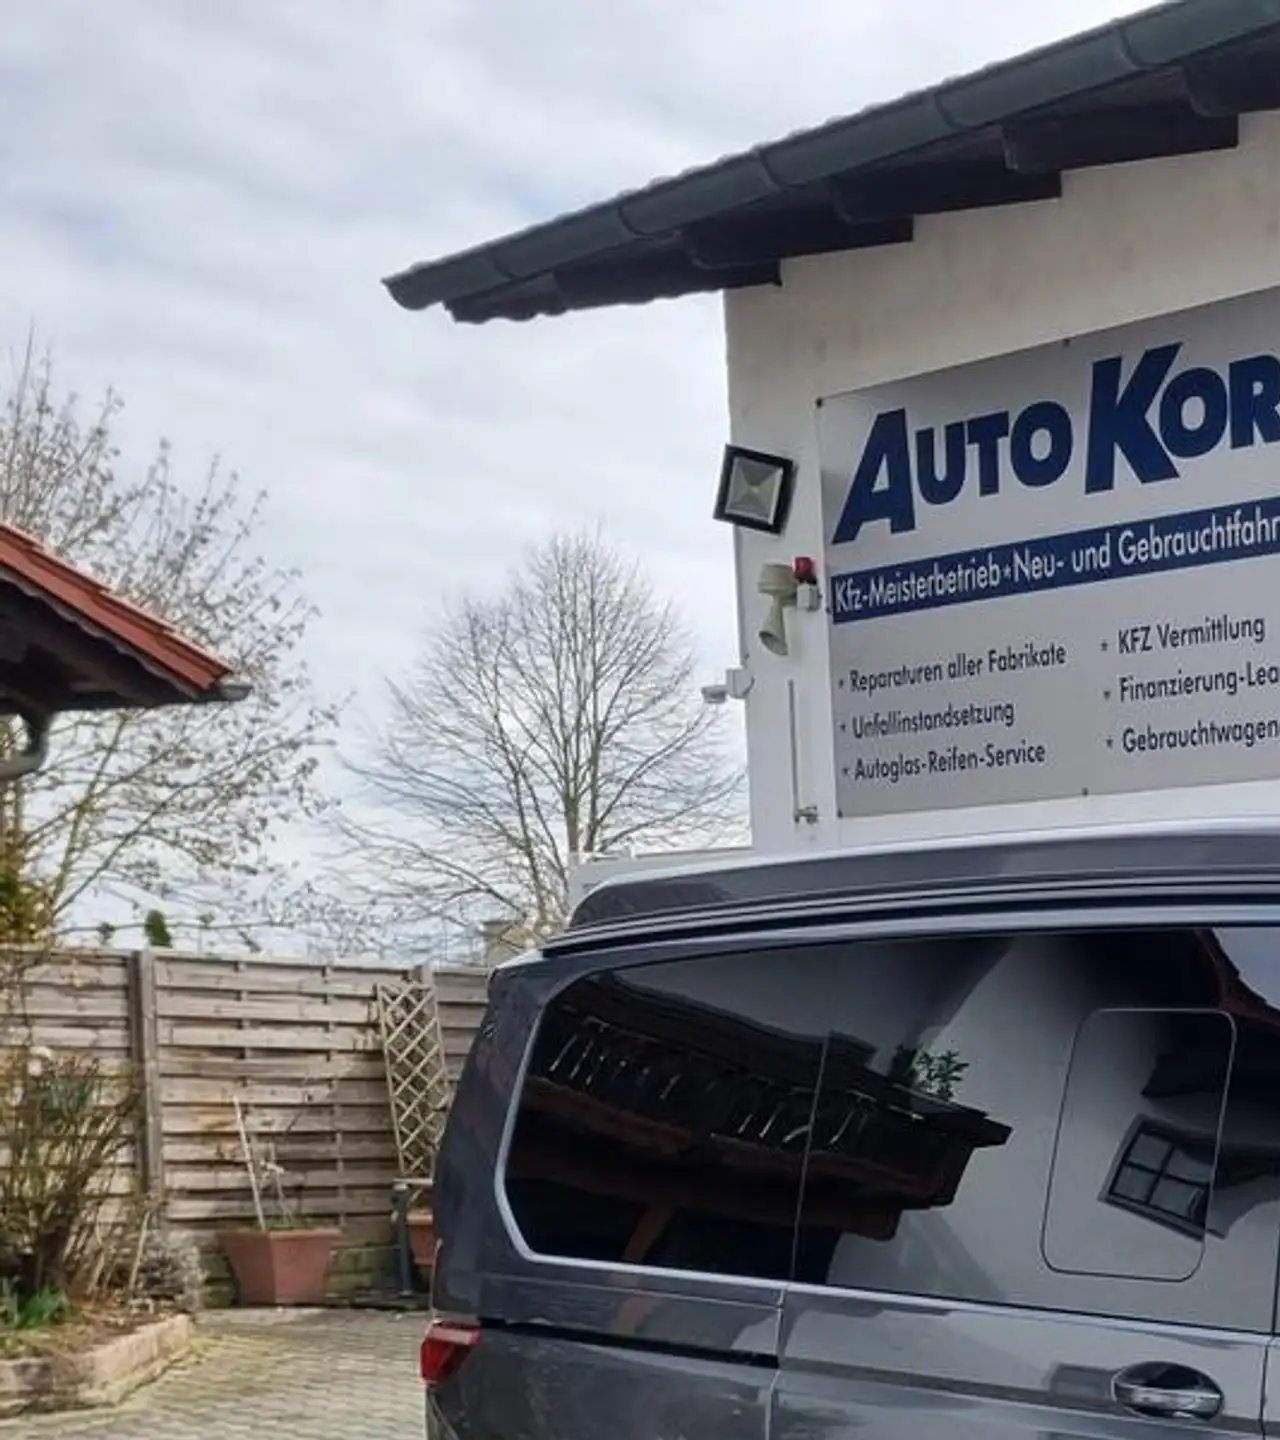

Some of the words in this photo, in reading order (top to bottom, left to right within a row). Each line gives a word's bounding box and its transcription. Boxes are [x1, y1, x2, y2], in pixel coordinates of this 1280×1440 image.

[831, 401, 1073, 544] AUTO
[1072, 533, 1111, 572] und
[1118, 626, 1152, 654] KFZ
[1157, 614, 1266, 649] Vermittlung
[850, 664, 942, 697] Reparaturen
[948, 653, 983, 680] aller
[988, 643, 1067, 672] Fabrikate
[852, 702, 1015, 739] Unfallinstandsetzung
[855, 739, 1046, 783] Autoglas-Reifen-Service
